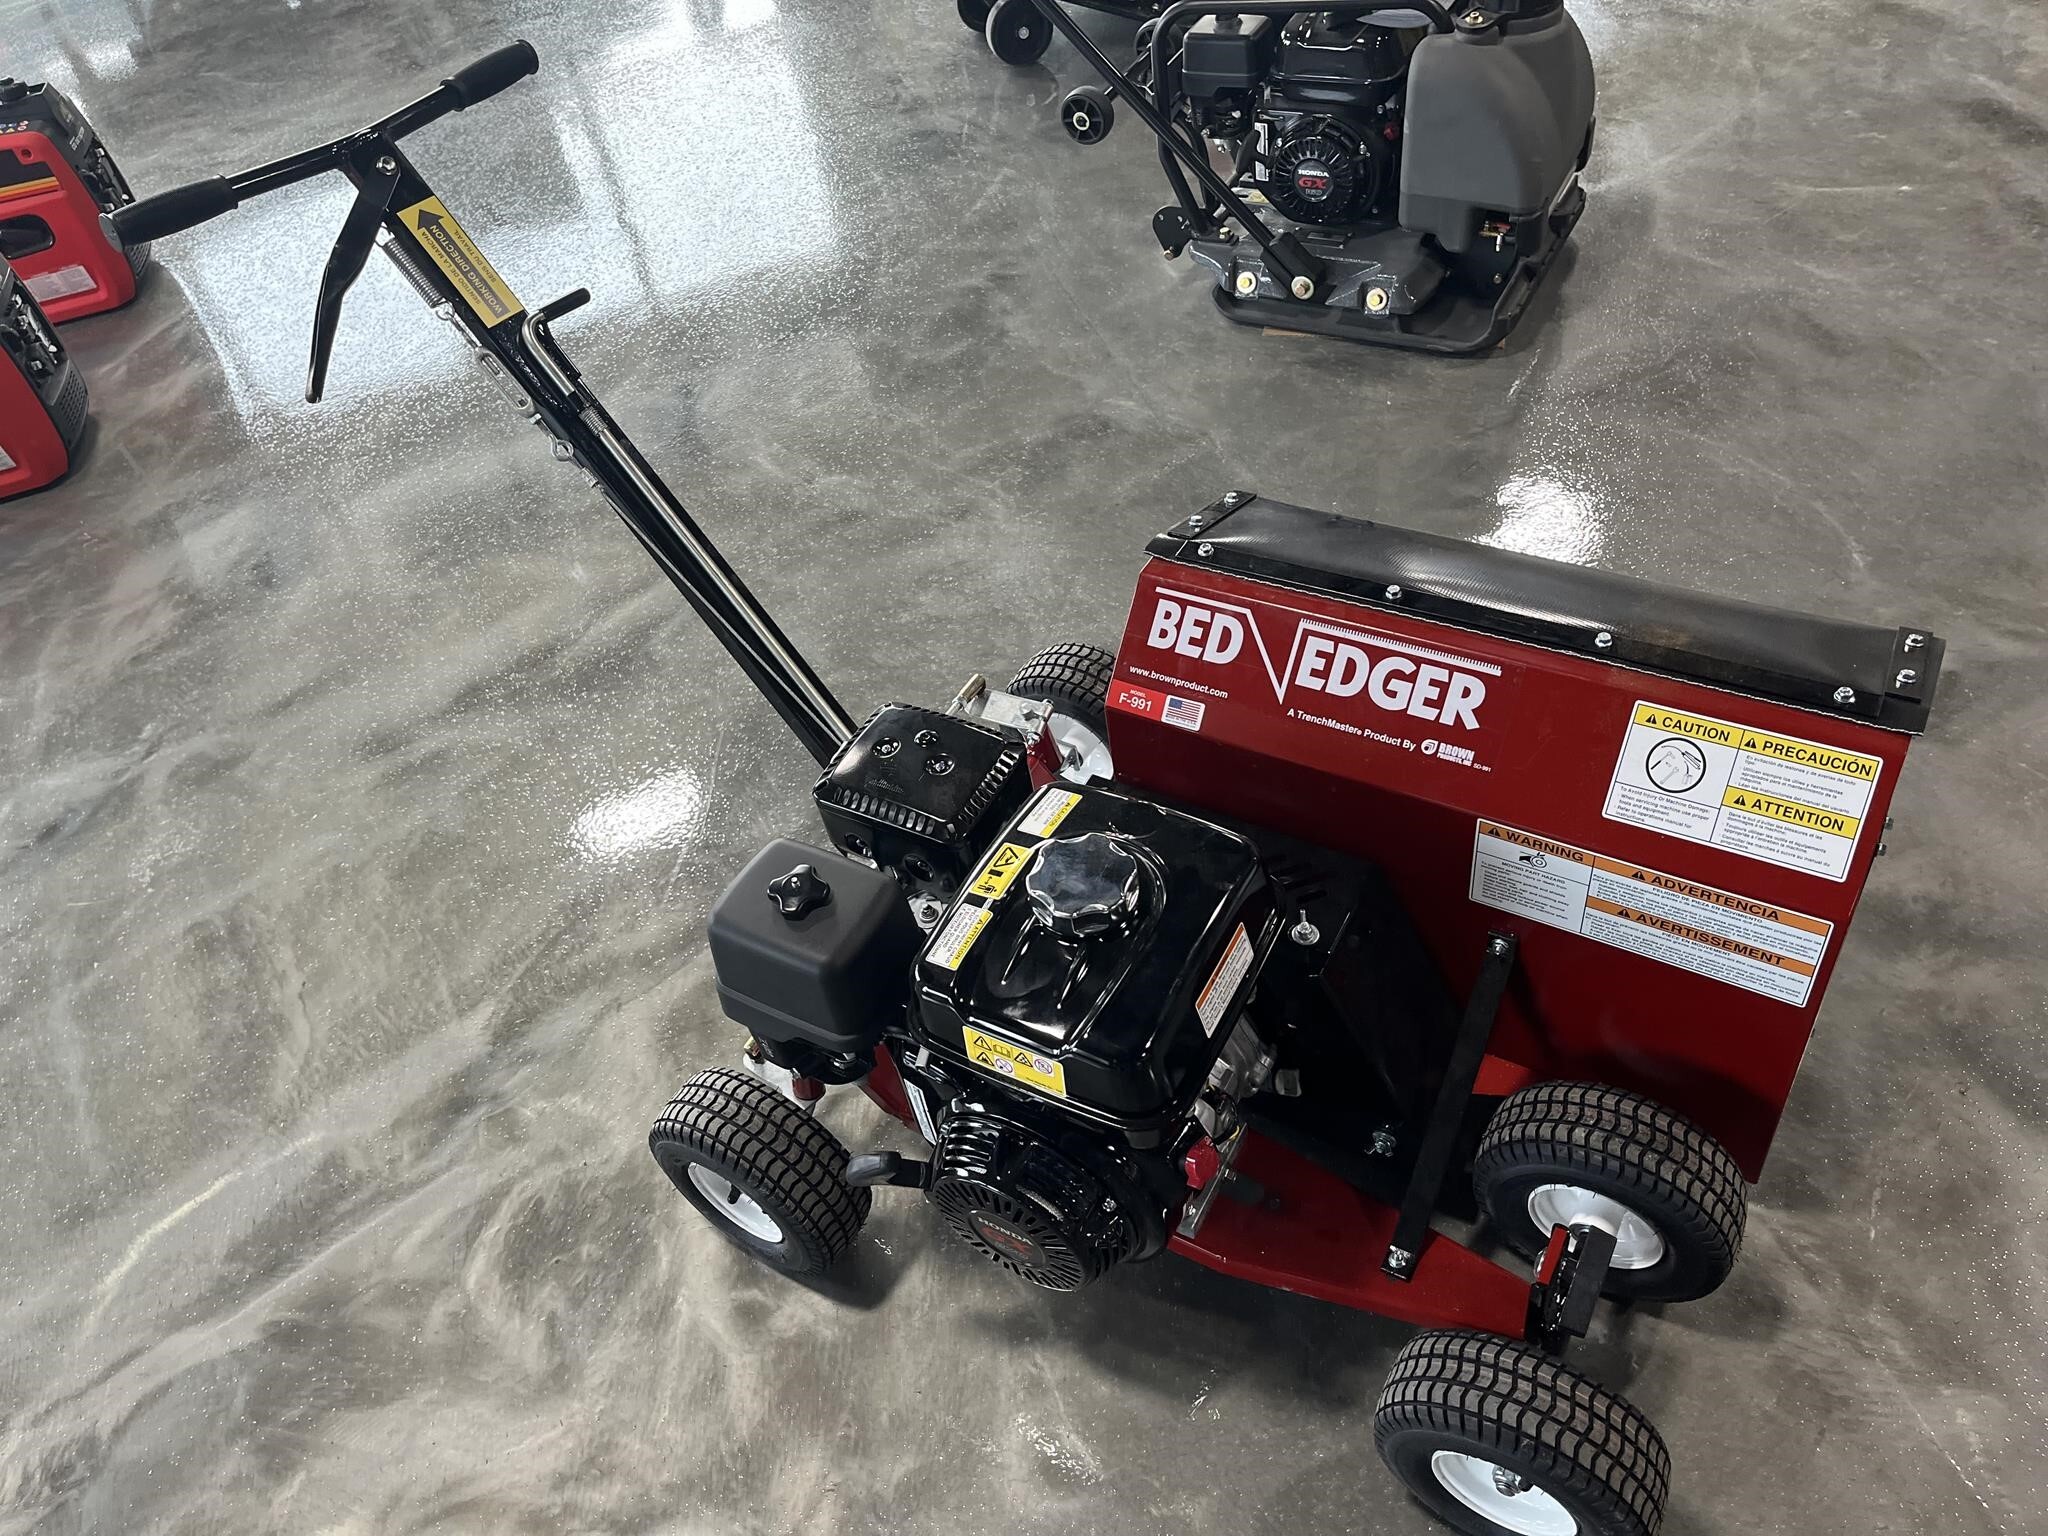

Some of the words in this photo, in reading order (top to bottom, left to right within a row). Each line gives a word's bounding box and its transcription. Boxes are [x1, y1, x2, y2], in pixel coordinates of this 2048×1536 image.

[1297, 169, 1329, 177] HONDA
[1298, 175, 1327, 188] GX
[420, 230, 445, 258] MARCHA
[429, 224, 471, 271] DIRECTION
[442, 258, 453, 267] LA
[449, 267, 460, 277] DE
[456, 277, 481, 304] SENTIDO
[465, 271, 503, 313] WORKING
[1147, 598, 1244, 664] BED
[1129, 665, 1229, 699] www.brownproduct.com
[1295, 635, 1486, 730] EDGER
[1119, 693, 1152, 712] F-991
[1287, 708, 1295, 717] A
[1364, 729, 1401, 747] Product
[1403, 739, 1416, 752] By
[1660, 715, 1730, 742] CAUTION
[1438, 741, 1474, 760] BROWN
[1761, 737, 1873, 777] PRECAUCIÓN
[1750, 797, 1844, 831] ATTENTION
[1506, 831, 1584, 862] WARNING
[1651, 875, 1780, 920] ADVERTENCIA
[954, 926, 979, 959] ATTENTION
[1635, 912, 1785, 966] AVERTISSEMENT
[977, 1217, 1033, 1246] HONDA
